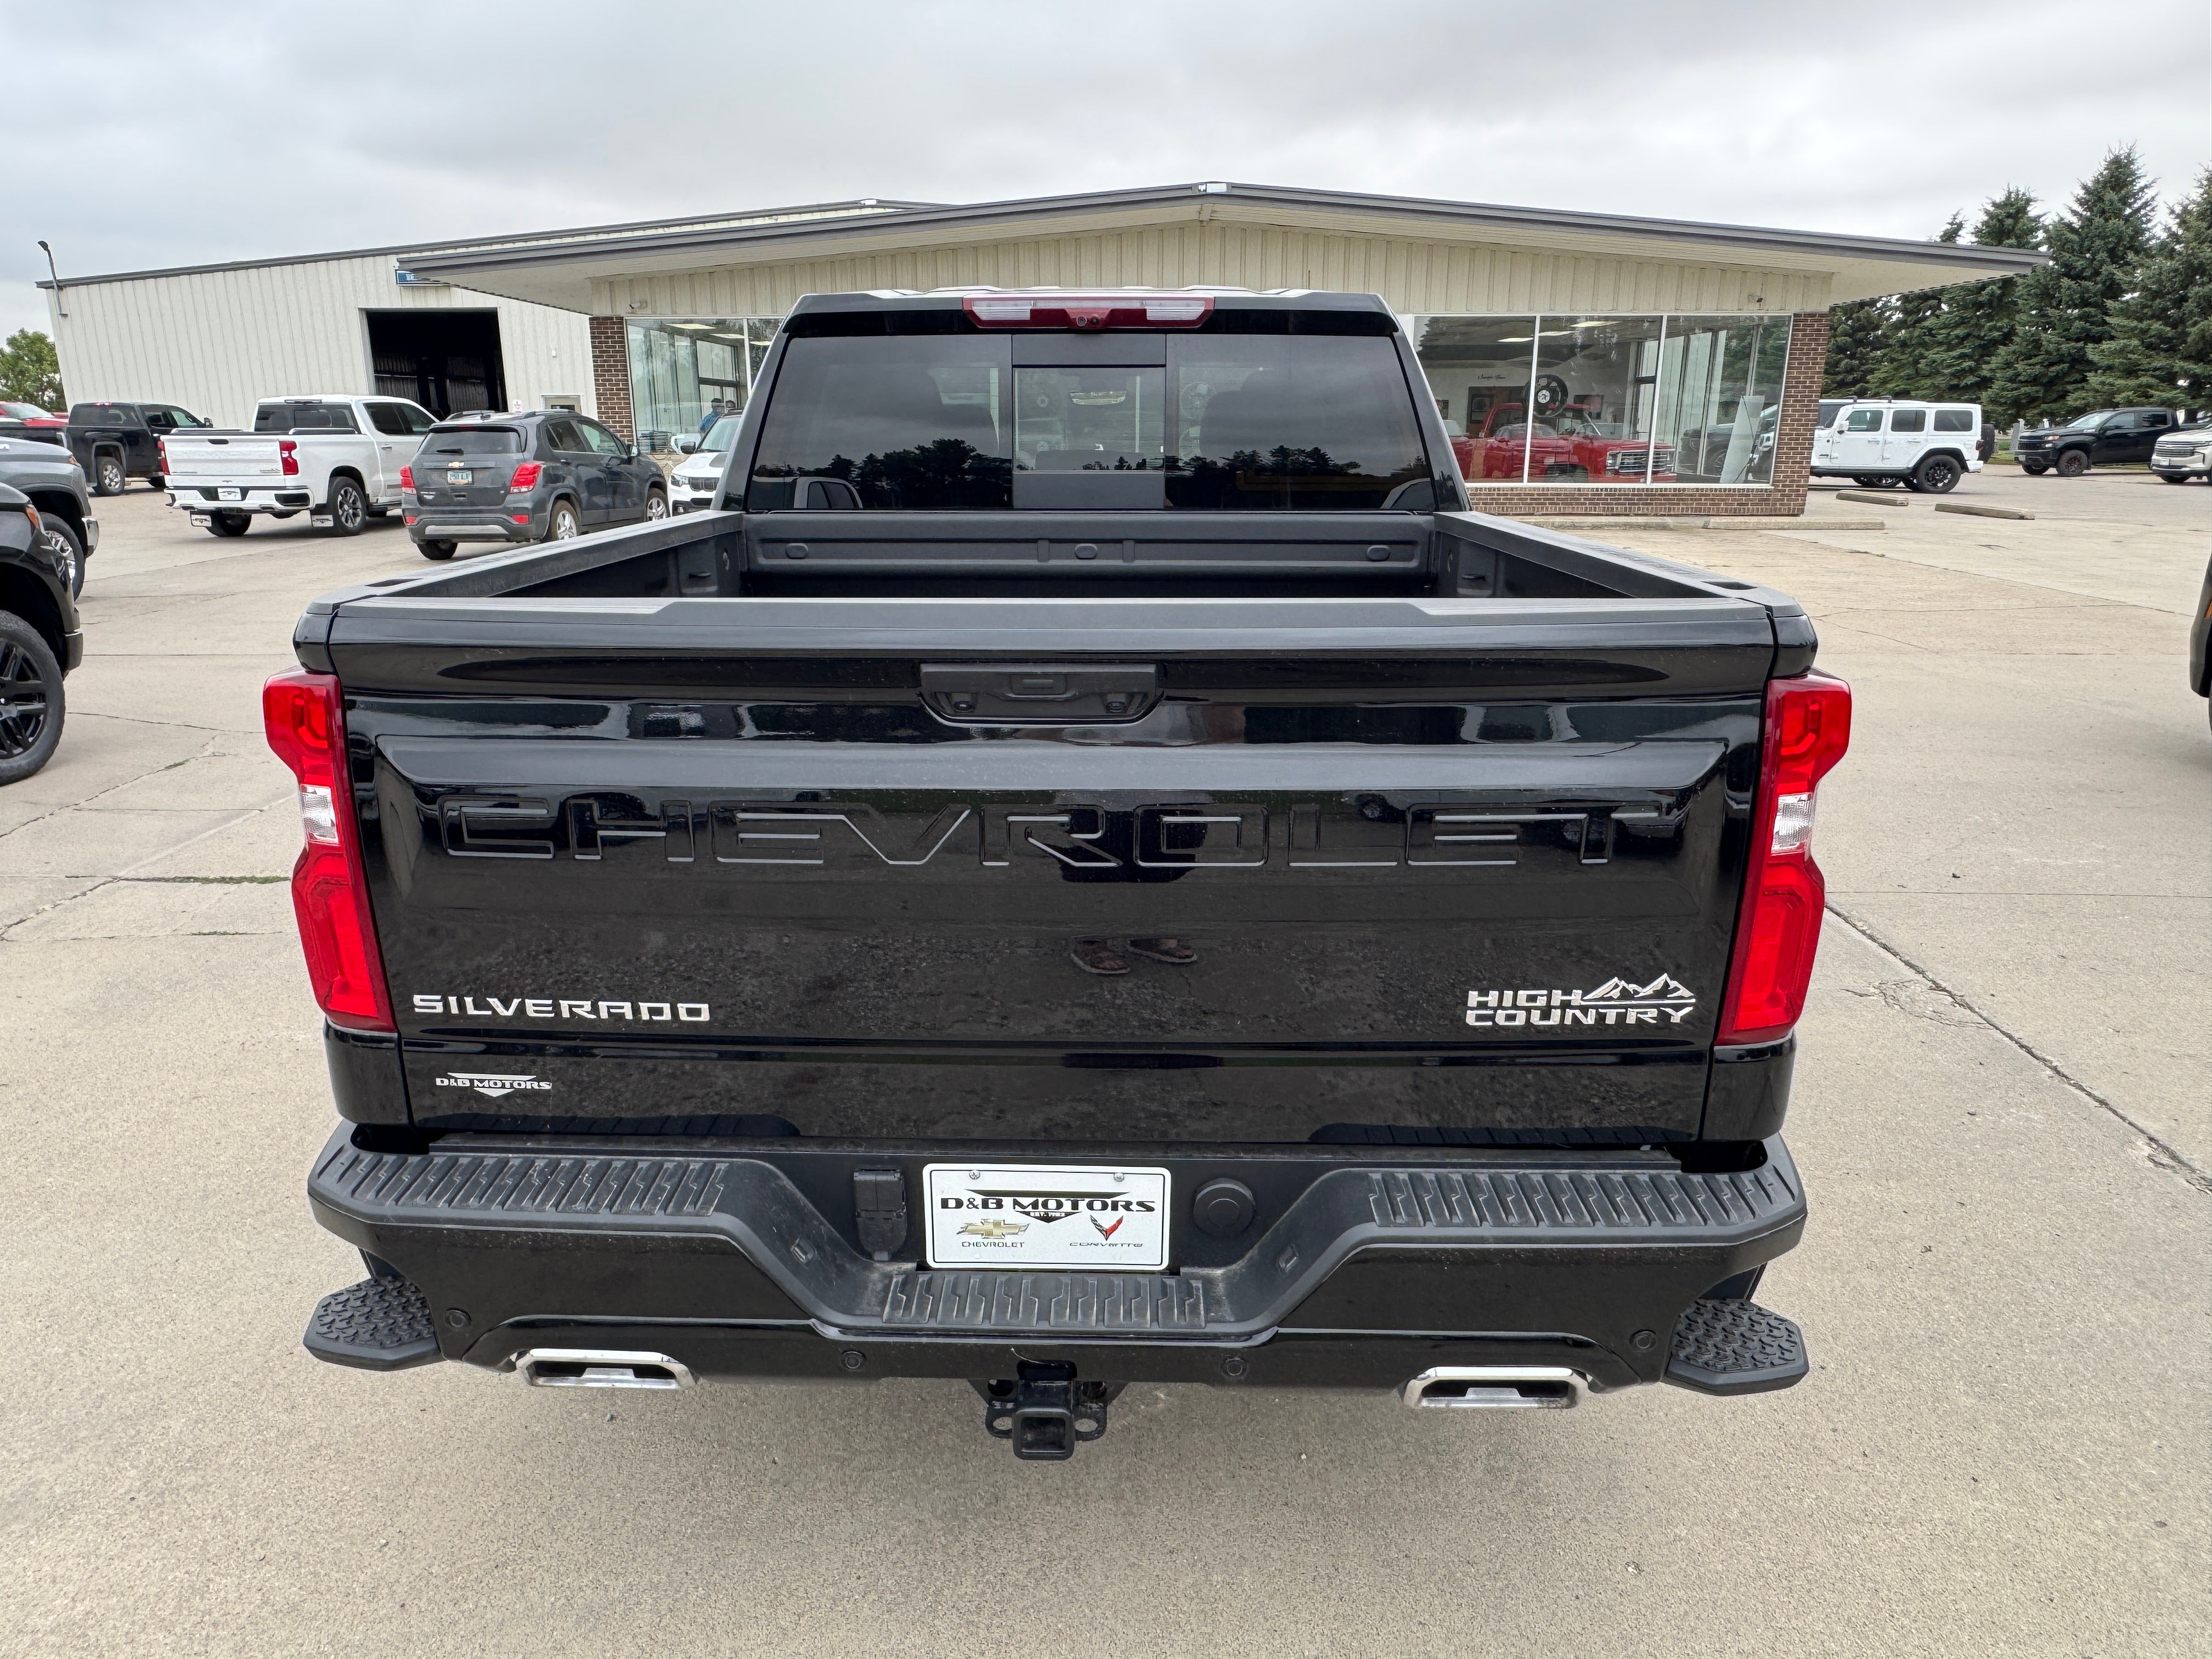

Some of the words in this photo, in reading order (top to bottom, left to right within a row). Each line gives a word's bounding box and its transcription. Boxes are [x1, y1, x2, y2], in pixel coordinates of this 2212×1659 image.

[439, 794, 1662, 865] CHEVROLET
[1467, 989, 1582, 1007] HIGH
[413, 994, 710, 1022] SILVERADO
[1465, 1006, 1694, 1026] COUNTRY
[436, 1077, 470, 1088] D&B
[473, 1079, 552, 1090] MOTORS
[940, 1197, 1004, 1210] D&B
[1012, 1198, 1156, 1212] MOTORS
